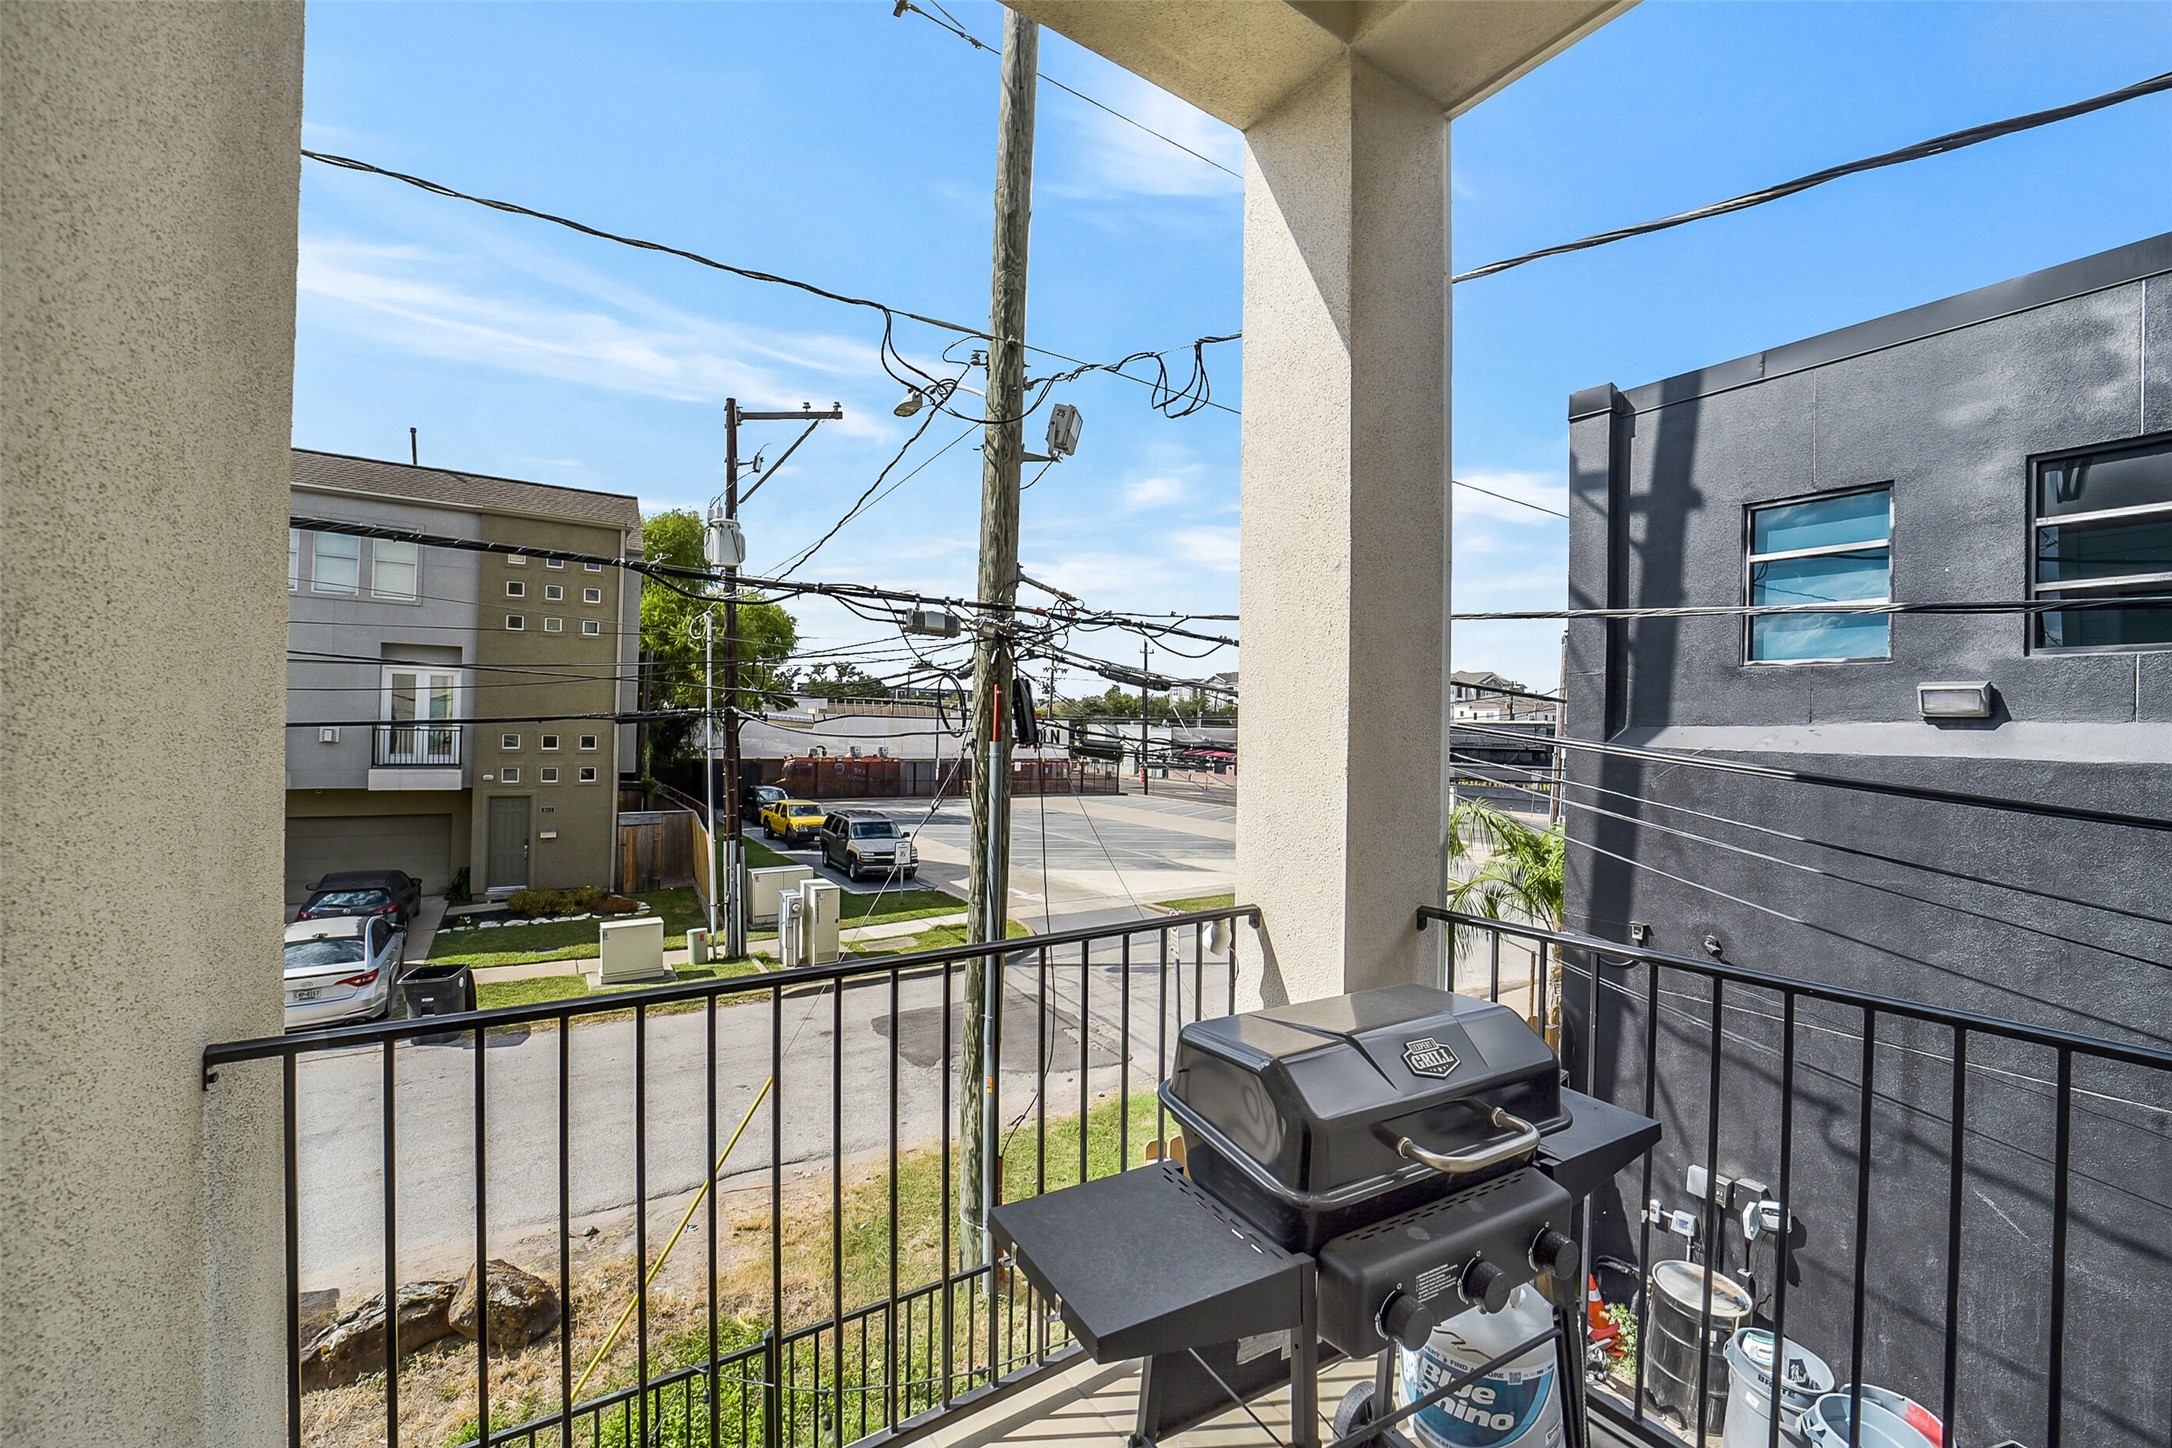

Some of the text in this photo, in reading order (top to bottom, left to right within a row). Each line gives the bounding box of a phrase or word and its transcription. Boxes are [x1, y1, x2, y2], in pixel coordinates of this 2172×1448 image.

[1411, 1049, 1454, 1069] GRILL
[1449, 1359, 1468, 1370] FIND
[1758, 1374, 1796, 1398] BRTE
